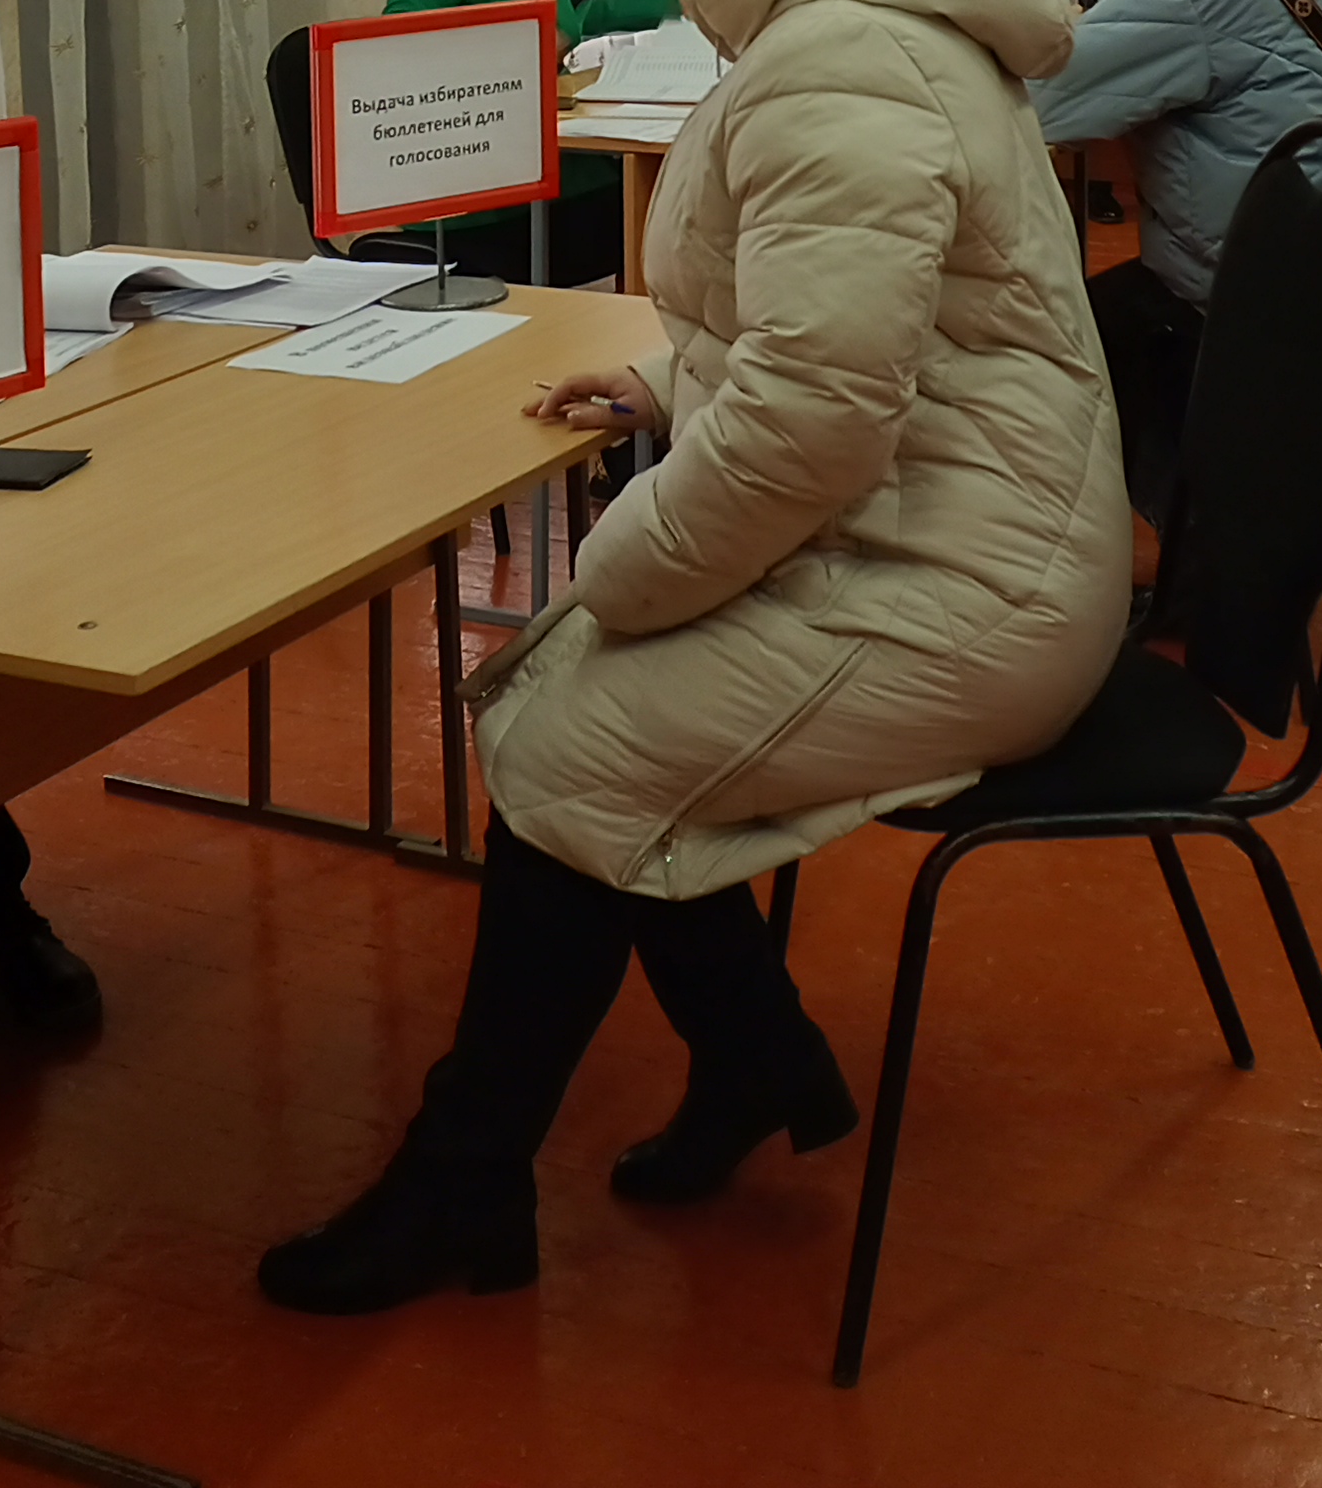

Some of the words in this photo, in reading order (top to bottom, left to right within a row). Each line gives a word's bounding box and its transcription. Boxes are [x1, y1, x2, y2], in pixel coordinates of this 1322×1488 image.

[351, 94, 414, 115] Выдача
[419, 78, 523, 106] избирателям
[373, 111, 471, 142] бюллетеней
[475, 110, 504, 127] для
[389, 140, 490, 168] голосования
